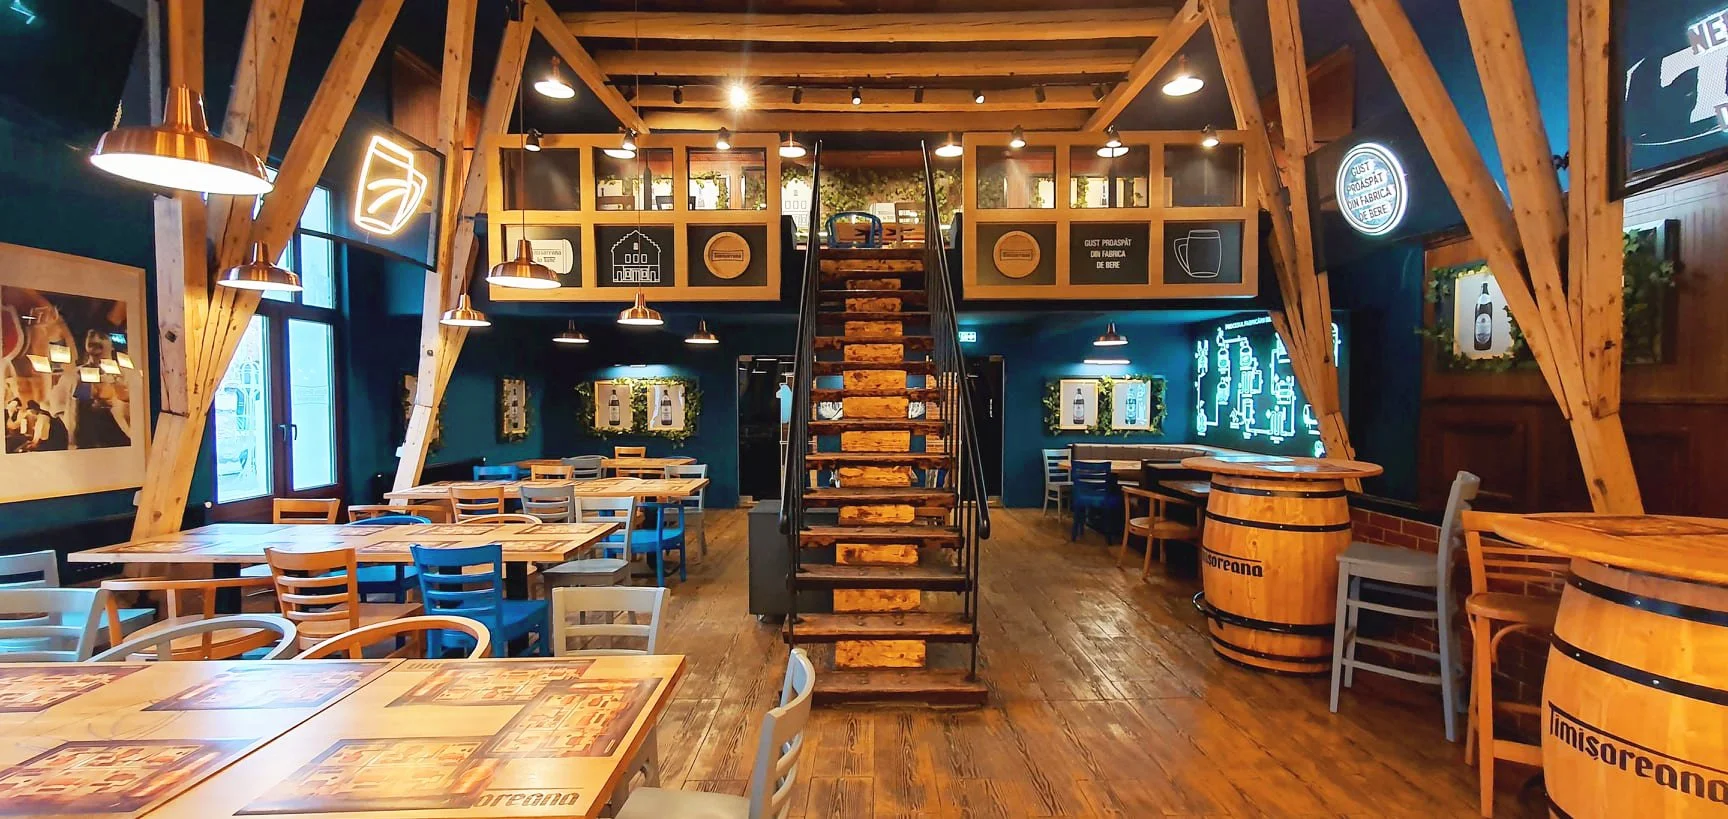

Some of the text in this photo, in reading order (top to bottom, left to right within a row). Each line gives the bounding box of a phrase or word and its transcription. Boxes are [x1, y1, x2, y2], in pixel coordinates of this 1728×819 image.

[1687, 11, 1728, 55] NE
[1351, 162, 1370, 177] GUST
[1348, 199, 1360, 211] DIN
[1359, 204, 1389, 222] DE BERE
[1084, 239, 1100, 247] GUST
[1090, 250, 1101, 258] DIN
[1096, 261, 1121, 269] DE BERE
[474, 792, 580, 808] oreana
